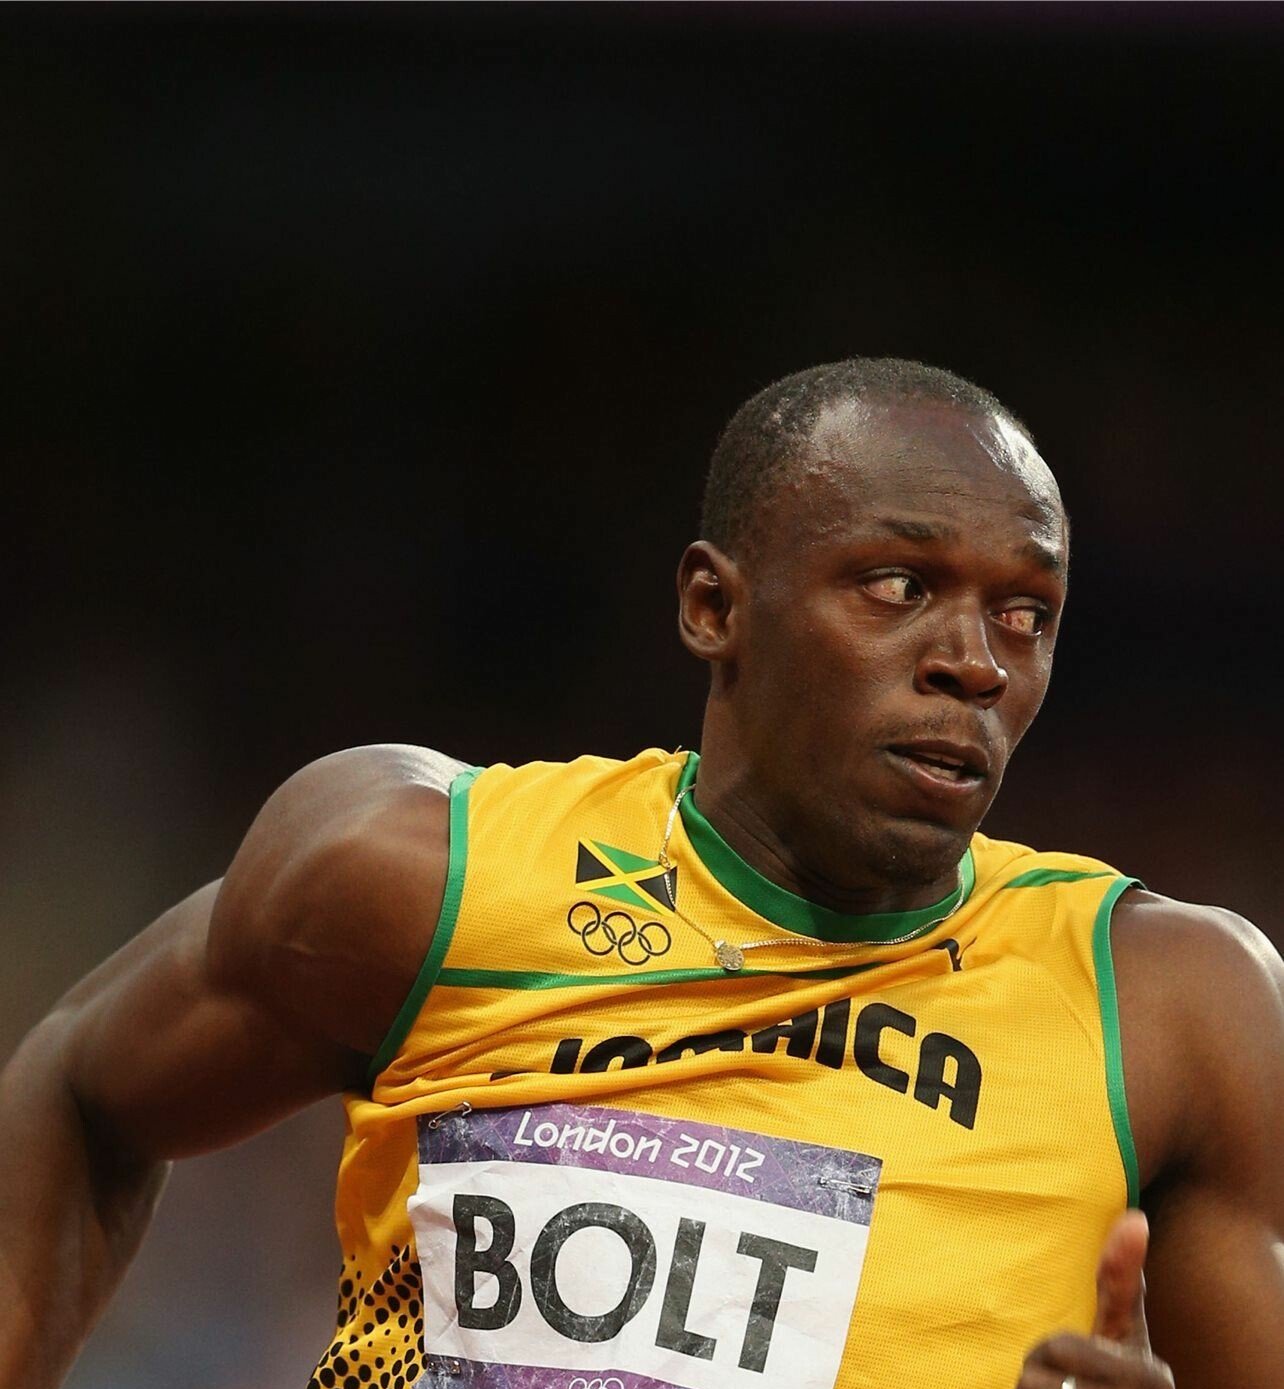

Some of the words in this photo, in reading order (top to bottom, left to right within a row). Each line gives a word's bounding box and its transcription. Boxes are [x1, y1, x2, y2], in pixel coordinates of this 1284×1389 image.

[490, 997, 983, 1130] AICA
[513, 1111, 663, 1163] London
[669, 1132, 766, 1184] 2012
[452, 1193, 819, 1375] BOLT
